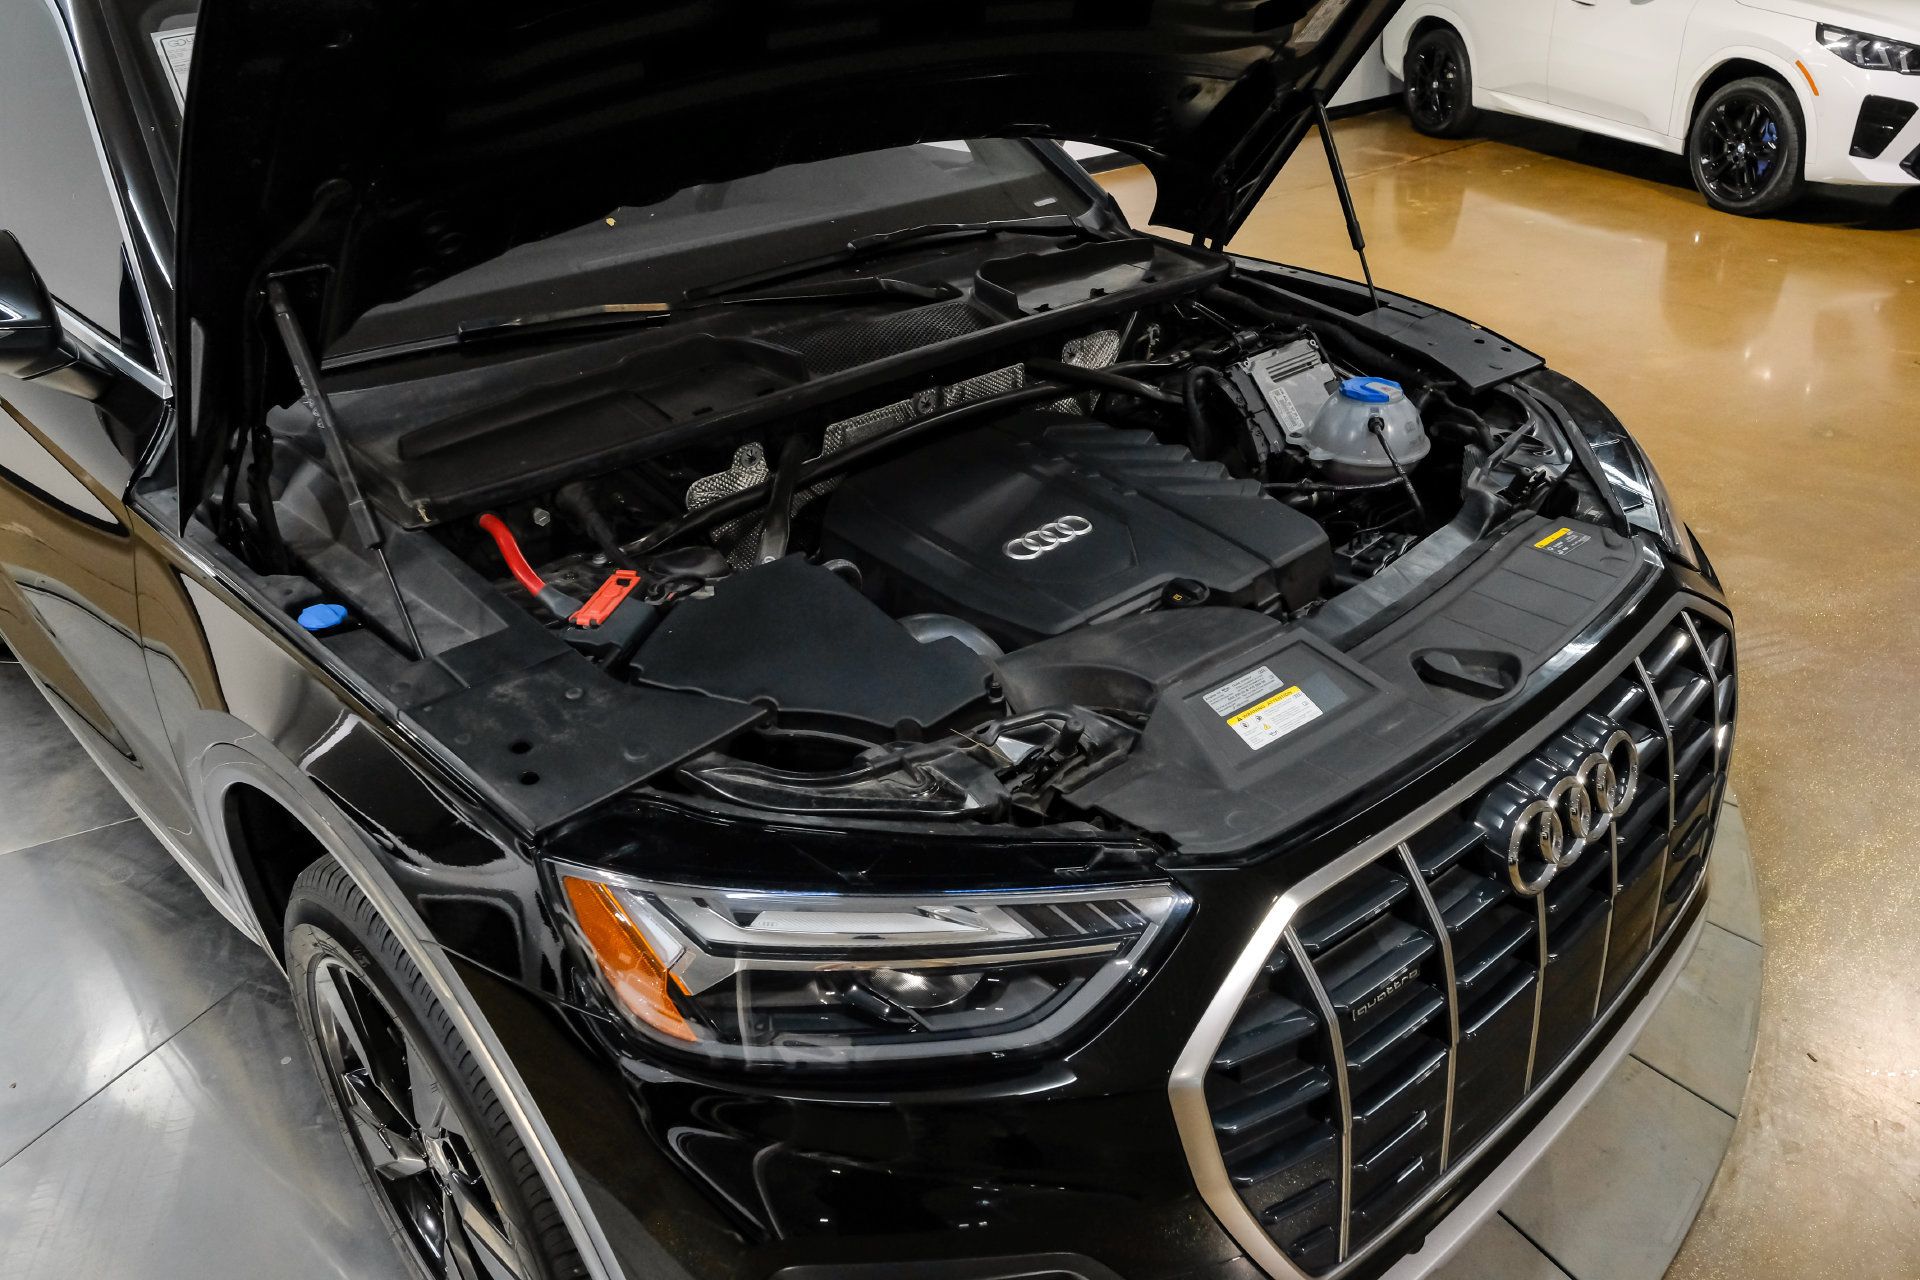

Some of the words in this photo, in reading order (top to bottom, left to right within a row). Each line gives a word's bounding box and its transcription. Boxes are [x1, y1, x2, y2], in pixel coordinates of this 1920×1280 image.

[1242, 704, 1266, 719] WARNING
[1267, 691, 1293, 706] ATTENTION
[1356, 968, 1418, 1017] quattro
